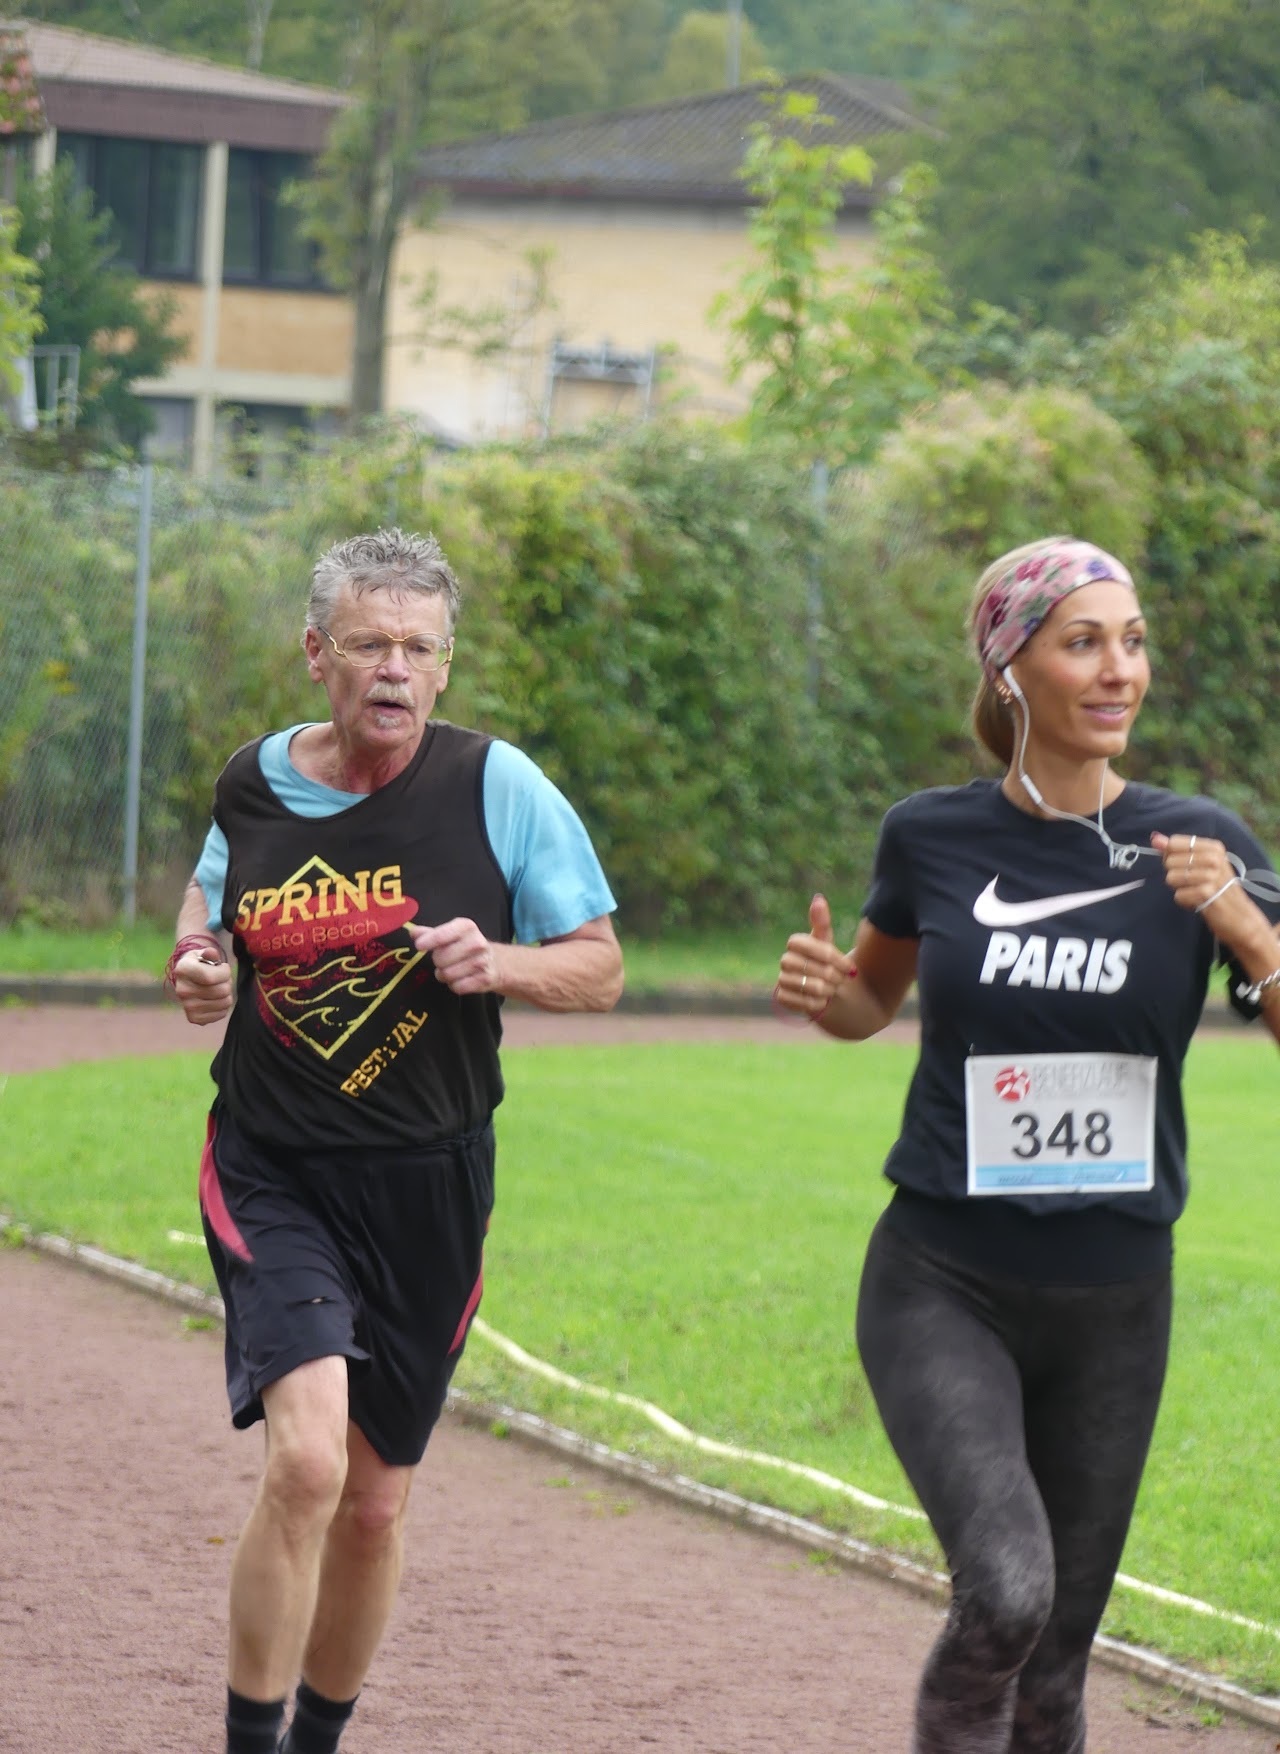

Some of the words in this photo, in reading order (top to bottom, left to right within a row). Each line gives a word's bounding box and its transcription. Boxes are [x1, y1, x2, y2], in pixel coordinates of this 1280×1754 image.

[235, 865, 406, 932] SPRING
[312, 919, 379, 945] Beach
[979, 930, 1133, 995] PARIS
[1011, 1110, 1112, 1159] 348
